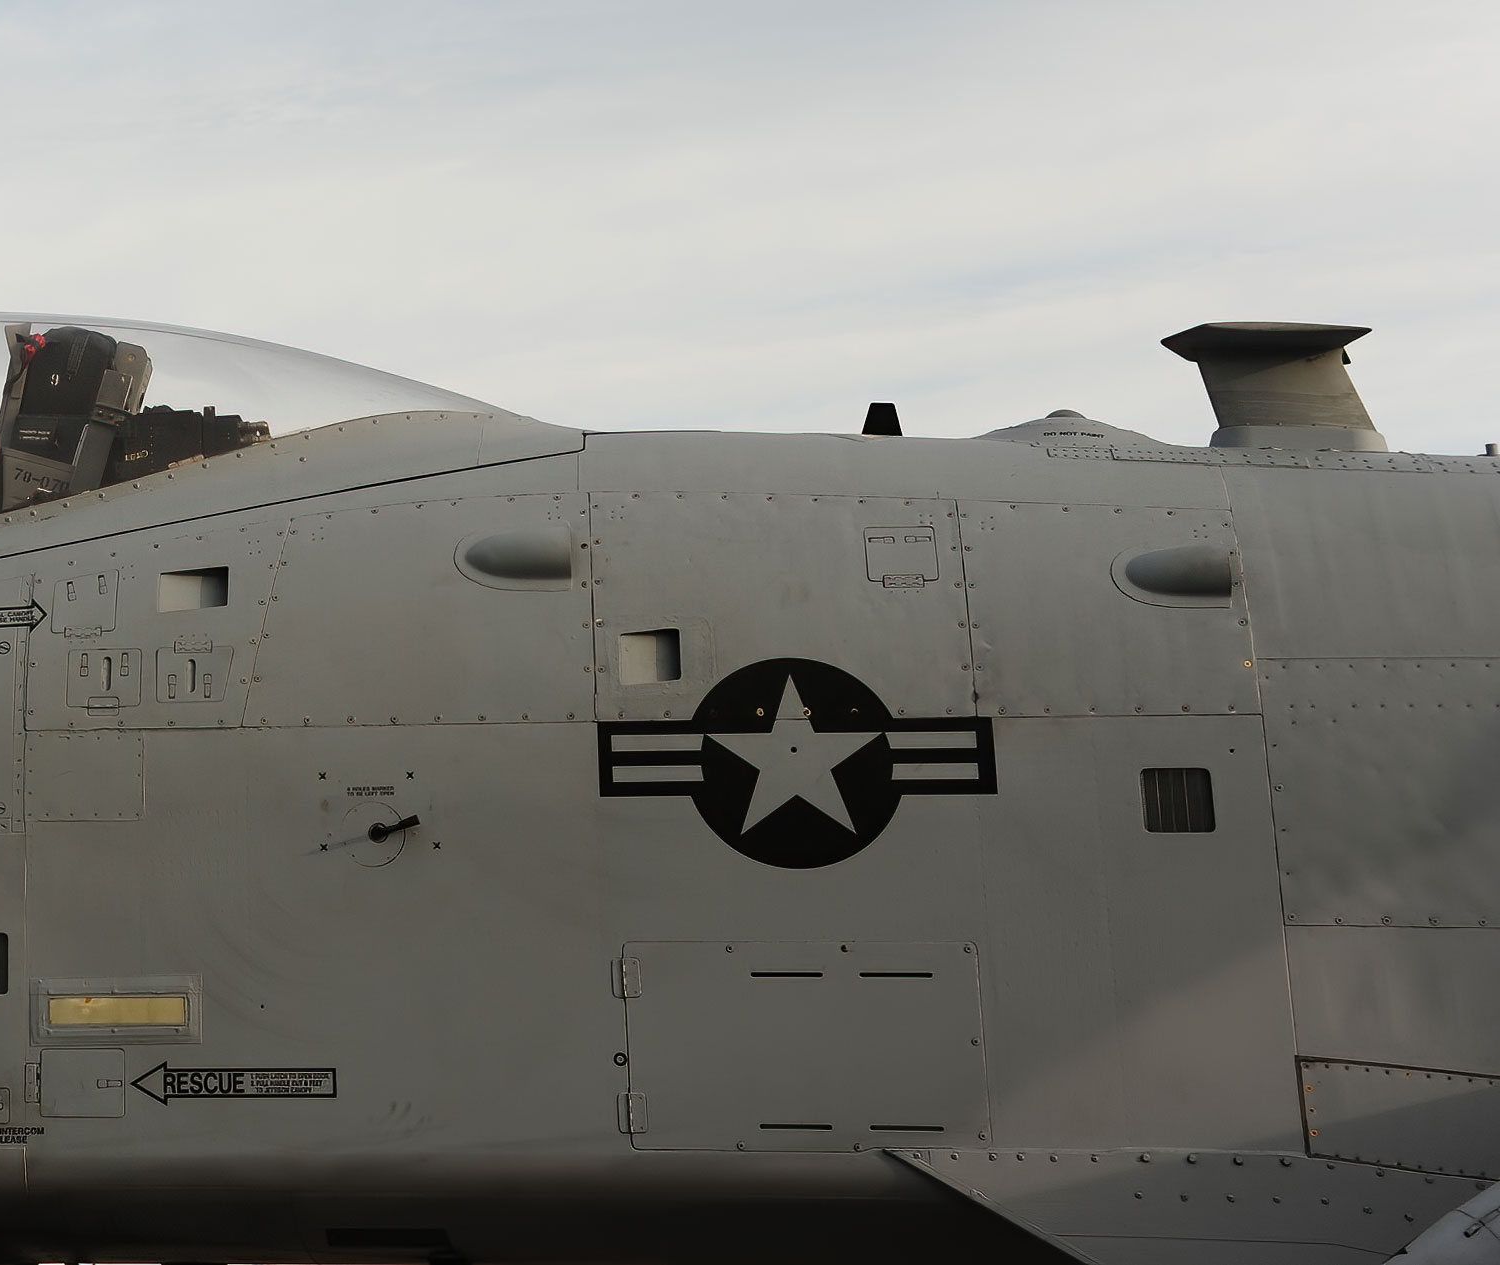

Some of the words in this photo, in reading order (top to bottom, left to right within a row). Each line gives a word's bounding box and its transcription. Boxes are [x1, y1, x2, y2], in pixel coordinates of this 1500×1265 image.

[1080, 431, 1104, 439] PAINT
[163, 1072, 245, 1094] RESCUE
[0, 1126, 45, 1135] INTERCOM
